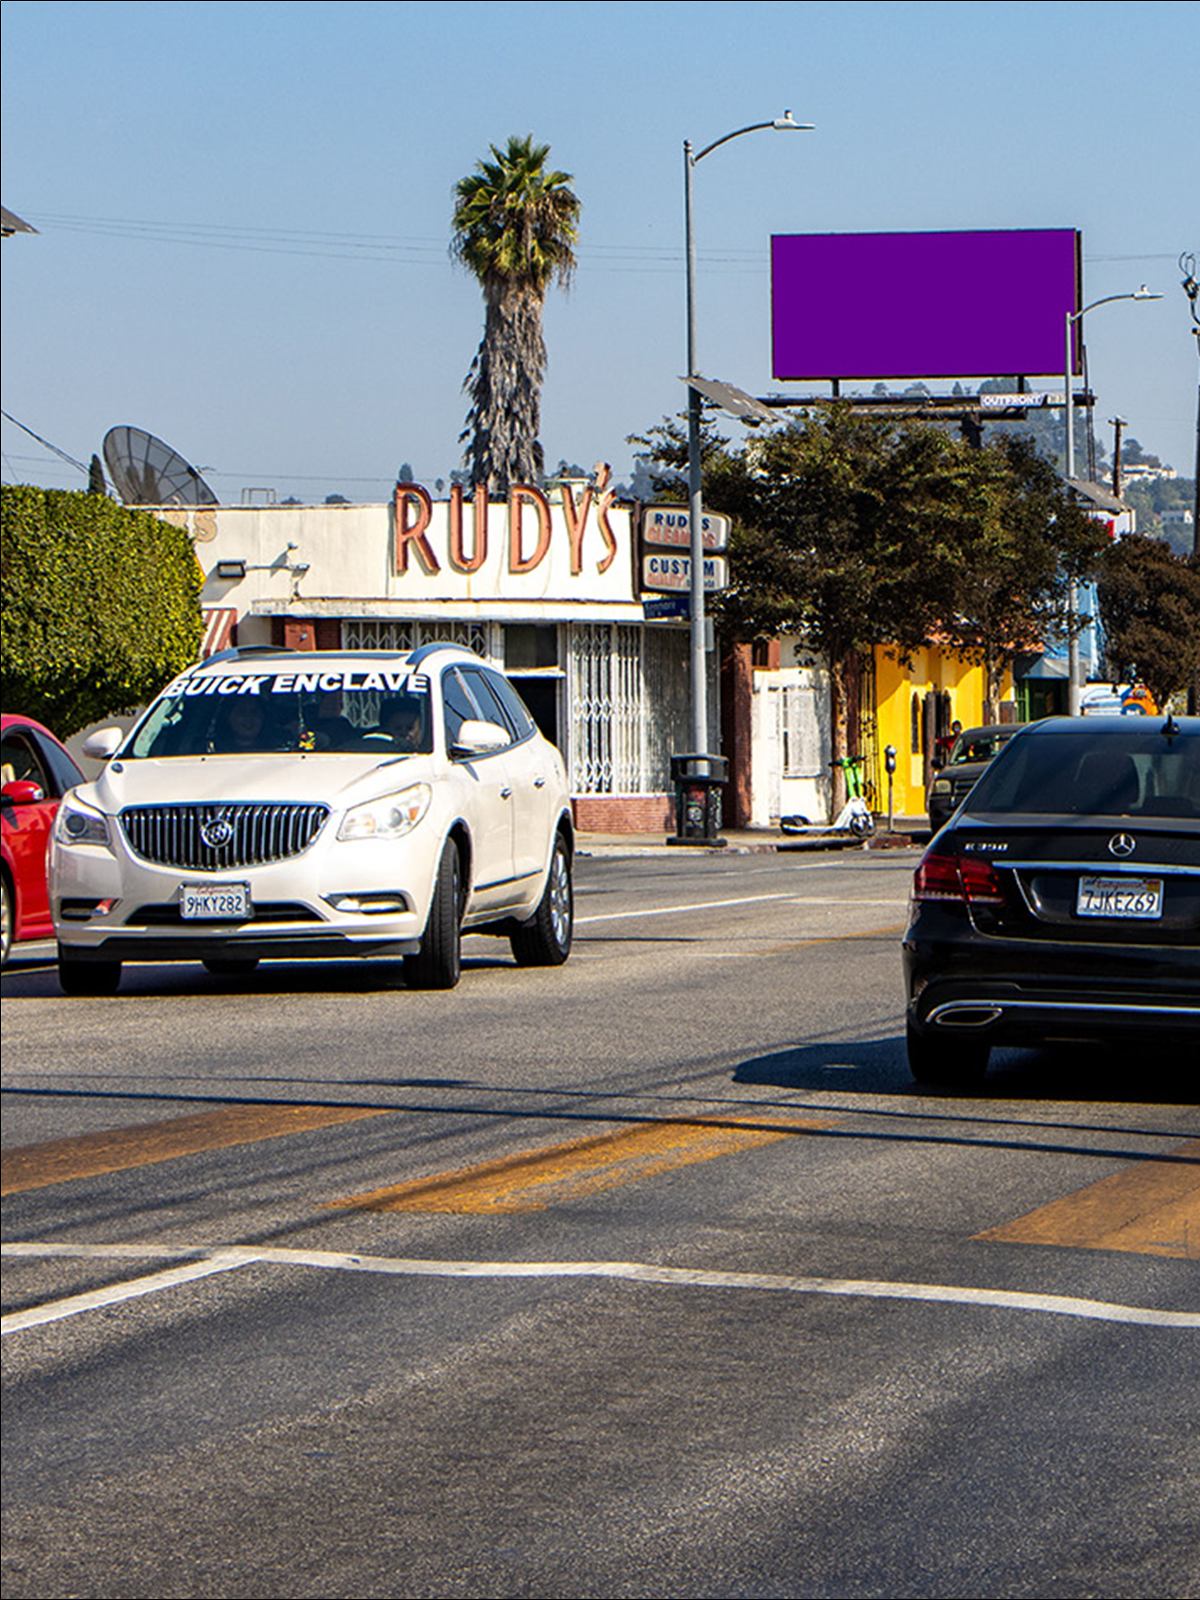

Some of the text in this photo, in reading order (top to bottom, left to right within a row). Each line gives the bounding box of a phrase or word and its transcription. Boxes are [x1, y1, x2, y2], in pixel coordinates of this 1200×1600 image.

[396, 462, 617, 575] RUDY'S
[654, 513, 711, 530] RUDS
[650, 558, 715, 577] CUSTM
[162, 673, 430, 698] BUICK ENCLAVE
[187, 895, 243, 912] 9HKY282
[1085, 890, 1156, 913] 7JKE269
